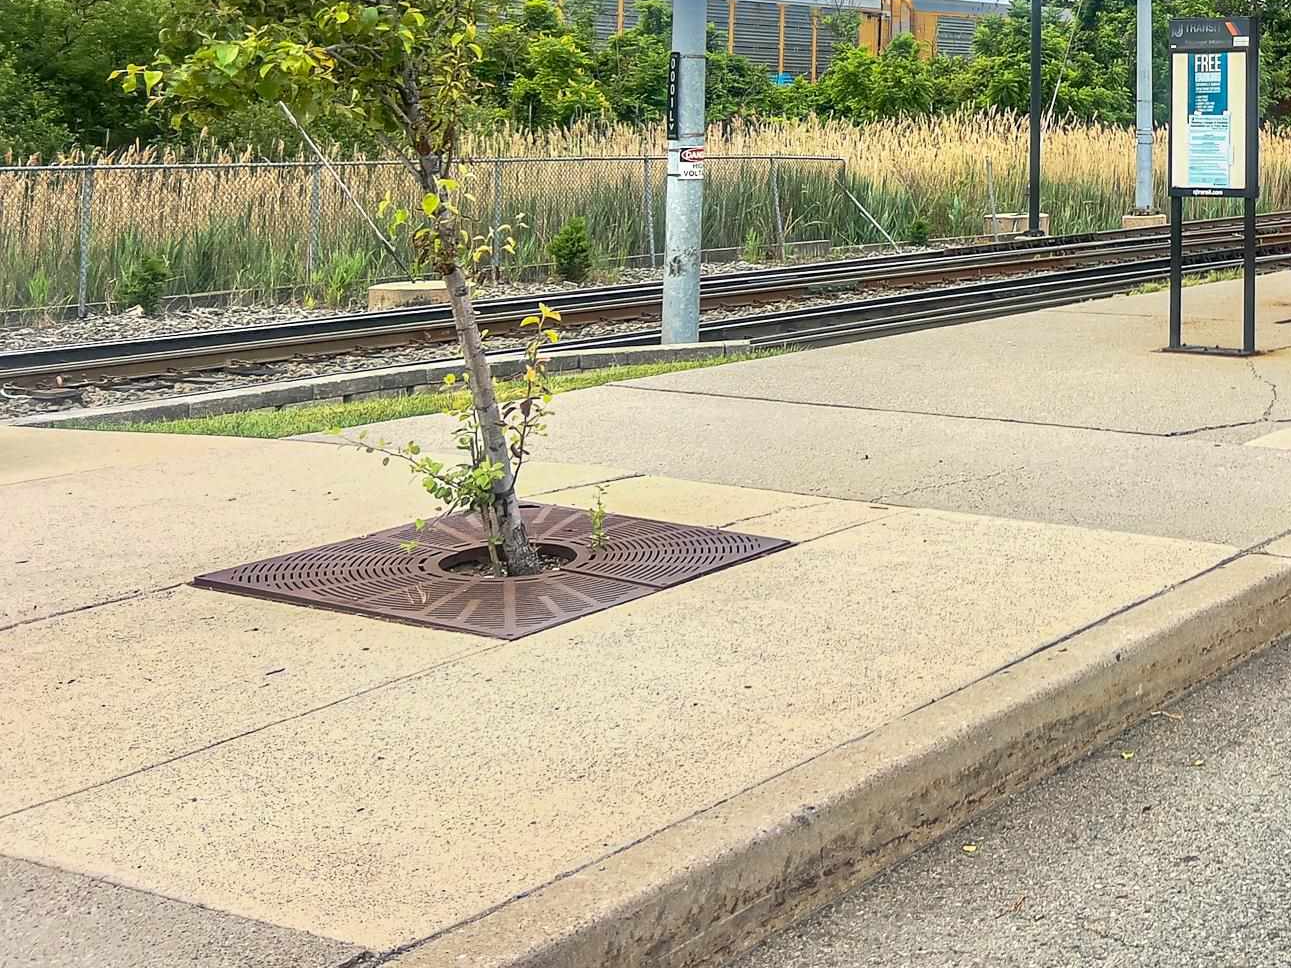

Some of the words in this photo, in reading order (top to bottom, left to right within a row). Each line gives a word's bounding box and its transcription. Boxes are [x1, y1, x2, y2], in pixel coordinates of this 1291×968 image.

[1185, 23, 1222, 33] TRANSIT
[1195, 54, 1221, 72] FREE
[686, 151, 704, 159] DANG
